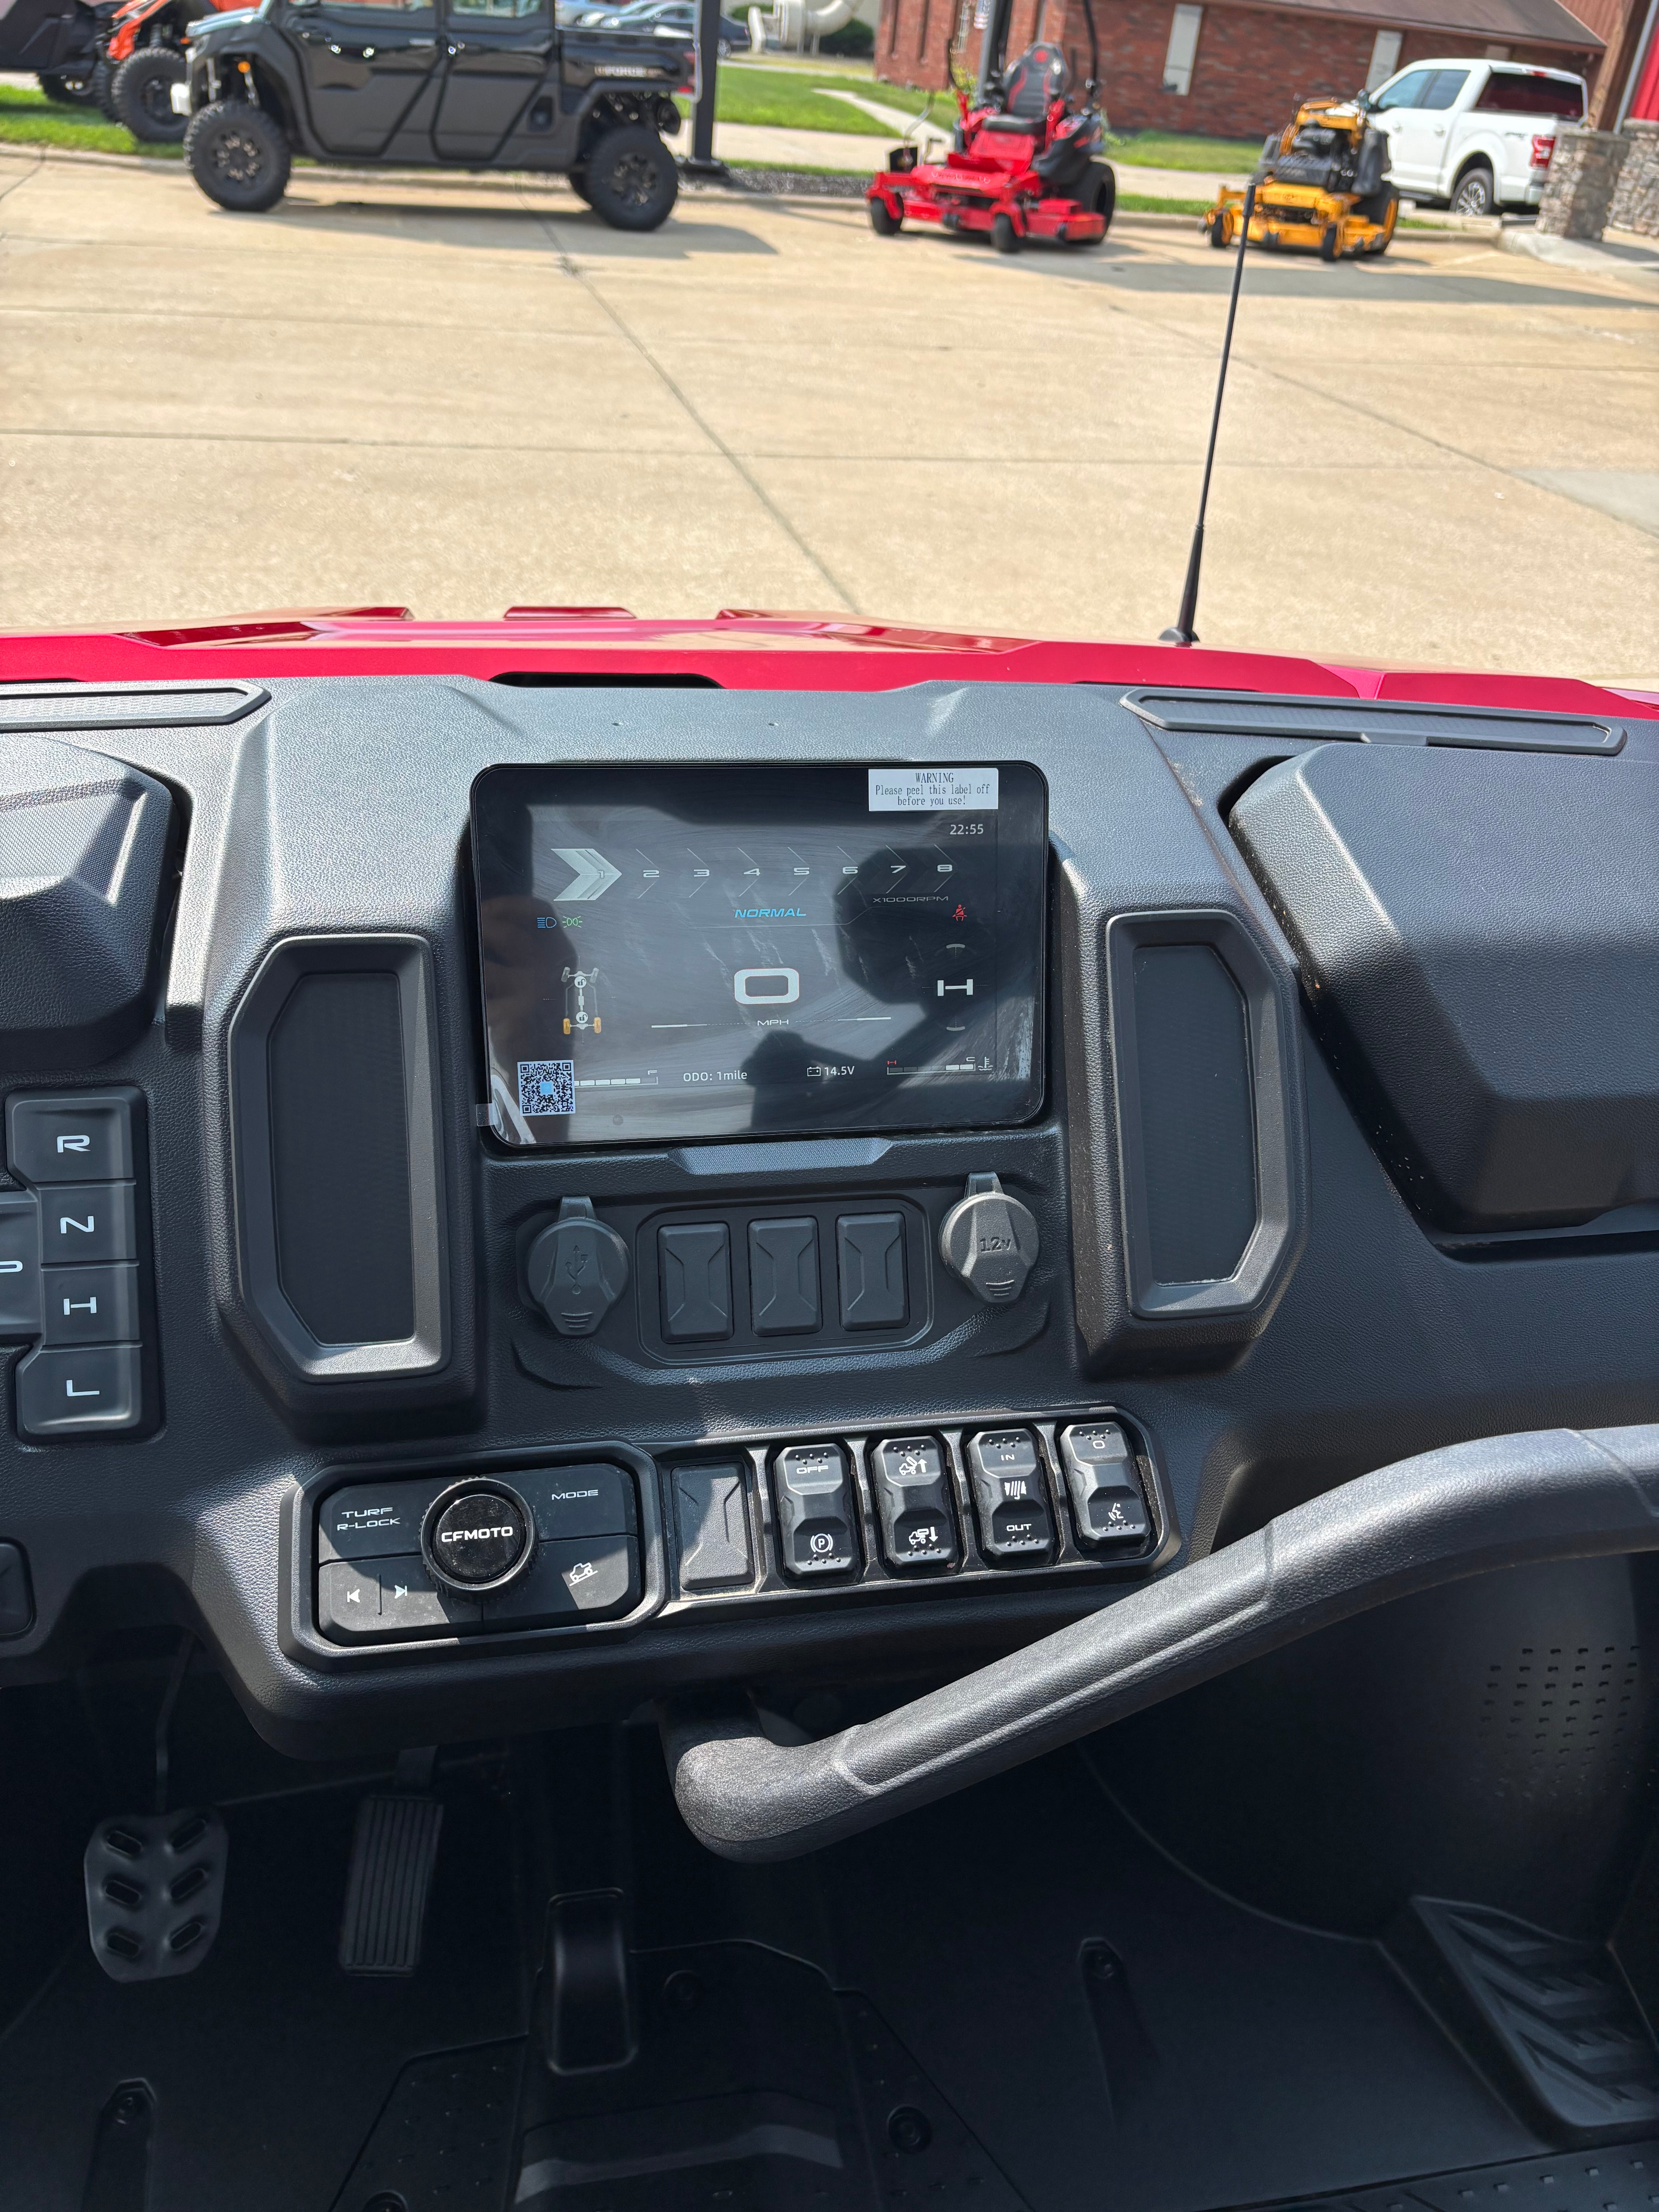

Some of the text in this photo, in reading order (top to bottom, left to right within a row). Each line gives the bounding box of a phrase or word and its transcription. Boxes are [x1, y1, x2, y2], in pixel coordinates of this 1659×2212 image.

[915, 773, 954, 783] WARNING
[876, 784, 990, 796] Please peel this label off
[898, 795, 965, 807] before you use!
[950, 824, 984, 835] 22:55
[643, 870, 660, 878] 2
[694, 869, 710, 877] 3
[793, 867, 810, 875] 5
[842, 866, 858, 874] 6
[890, 865, 906, 873] 7
[937, 864, 953, 872] 8
[735, 908, 806, 918] NORMAL
[734, 968, 799, 1005] 0
[937, 979, 973, 996] H
[683, 1070, 747, 1082] ODO: 1mile
[824, 1066, 855, 1076] 14.5V
[57, 1135, 91, 1153] R
[60, 1216, 94, 1234] N
[63, 1297, 97, 1315] H
[66, 1379, 100, 1396] L
[796, 1465, 829, 1474] OFF
[551, 1489, 599, 1500] MODE
[342, 1507, 393, 1519] TURF
[337, 1517, 400, 1531] R-LOCK
[1006, 1523, 1032, 1532] OUT
[441, 1526, 514, 1543] CFMOTO
